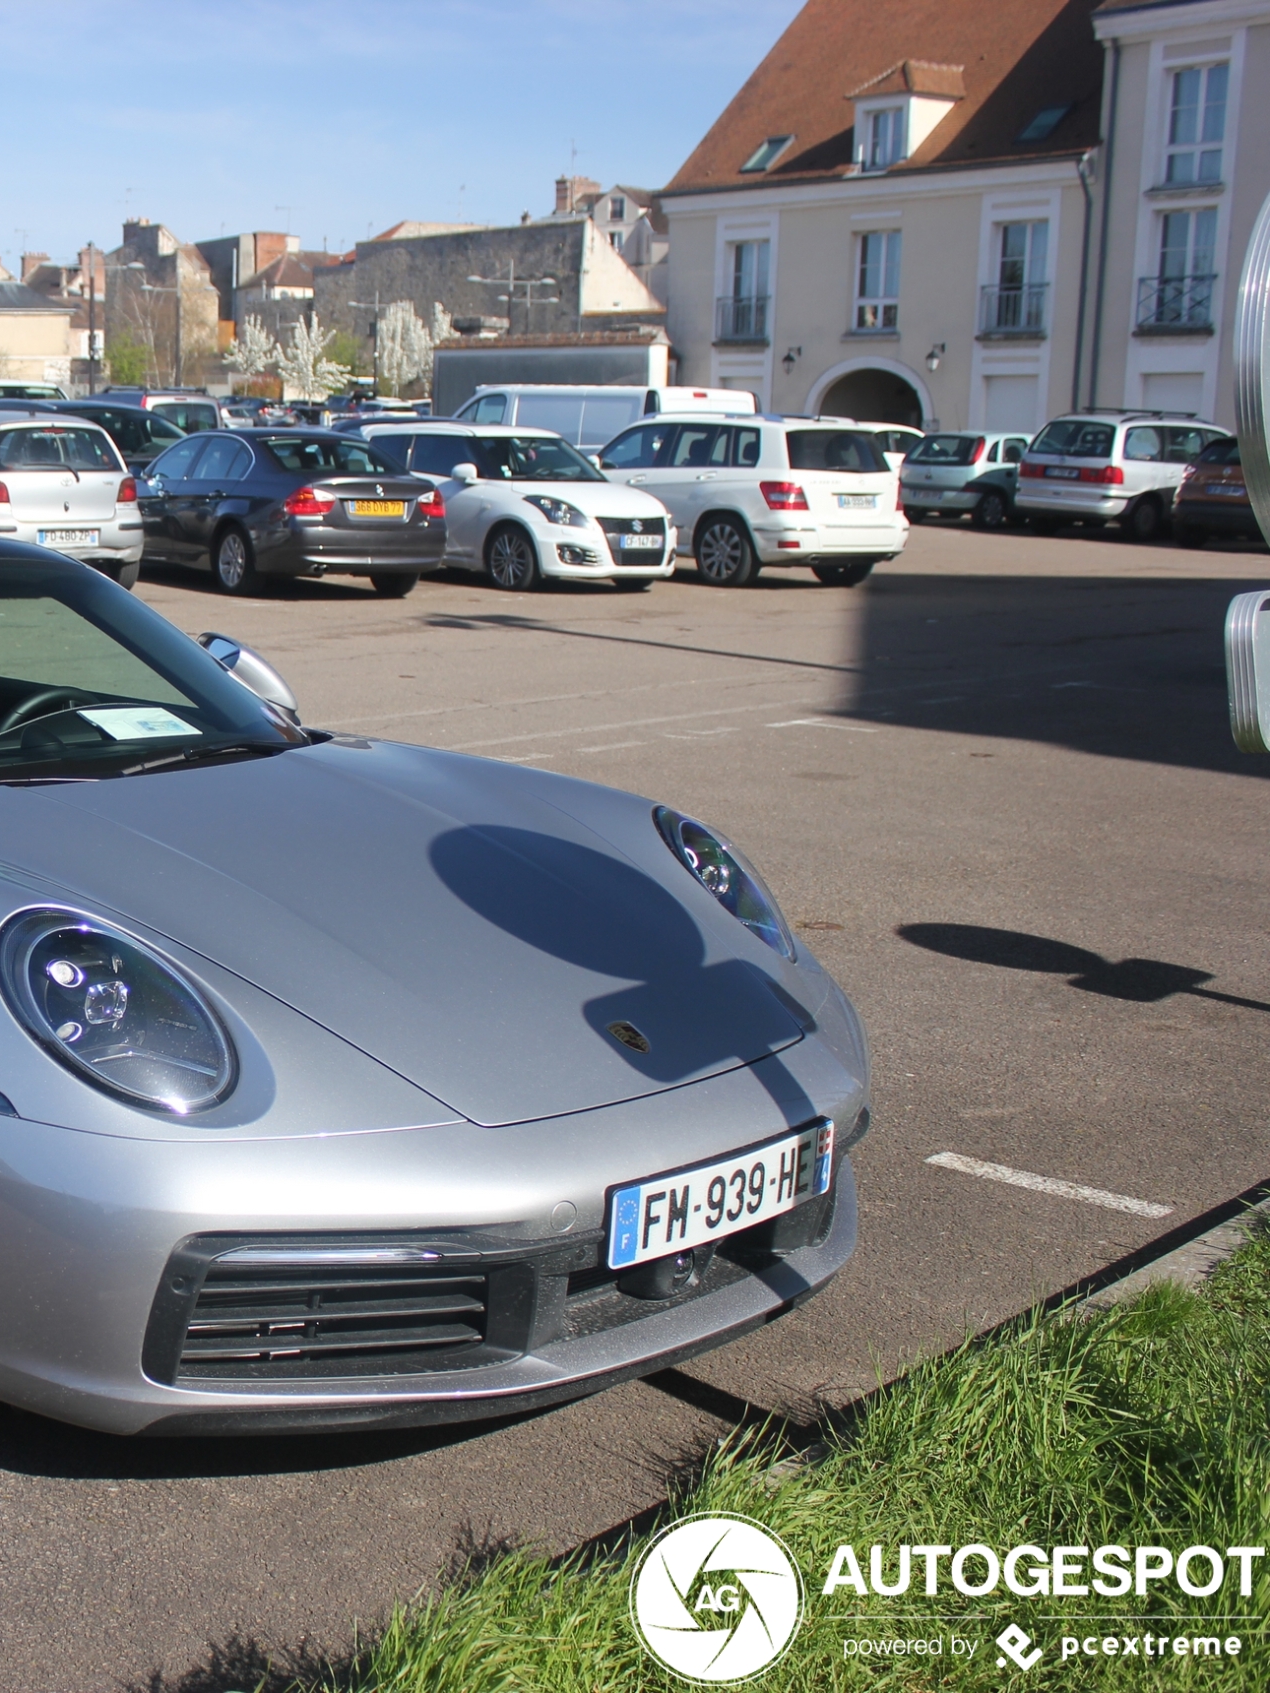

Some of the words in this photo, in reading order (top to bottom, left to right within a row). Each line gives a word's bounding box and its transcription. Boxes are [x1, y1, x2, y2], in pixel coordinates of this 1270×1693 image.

[392, 502, 402, 513] 77
[813, 1161, 828, 1193] 74
[642, 1141, 811, 1250] FM-939-HE
[621, 1233, 630, 1250] F
